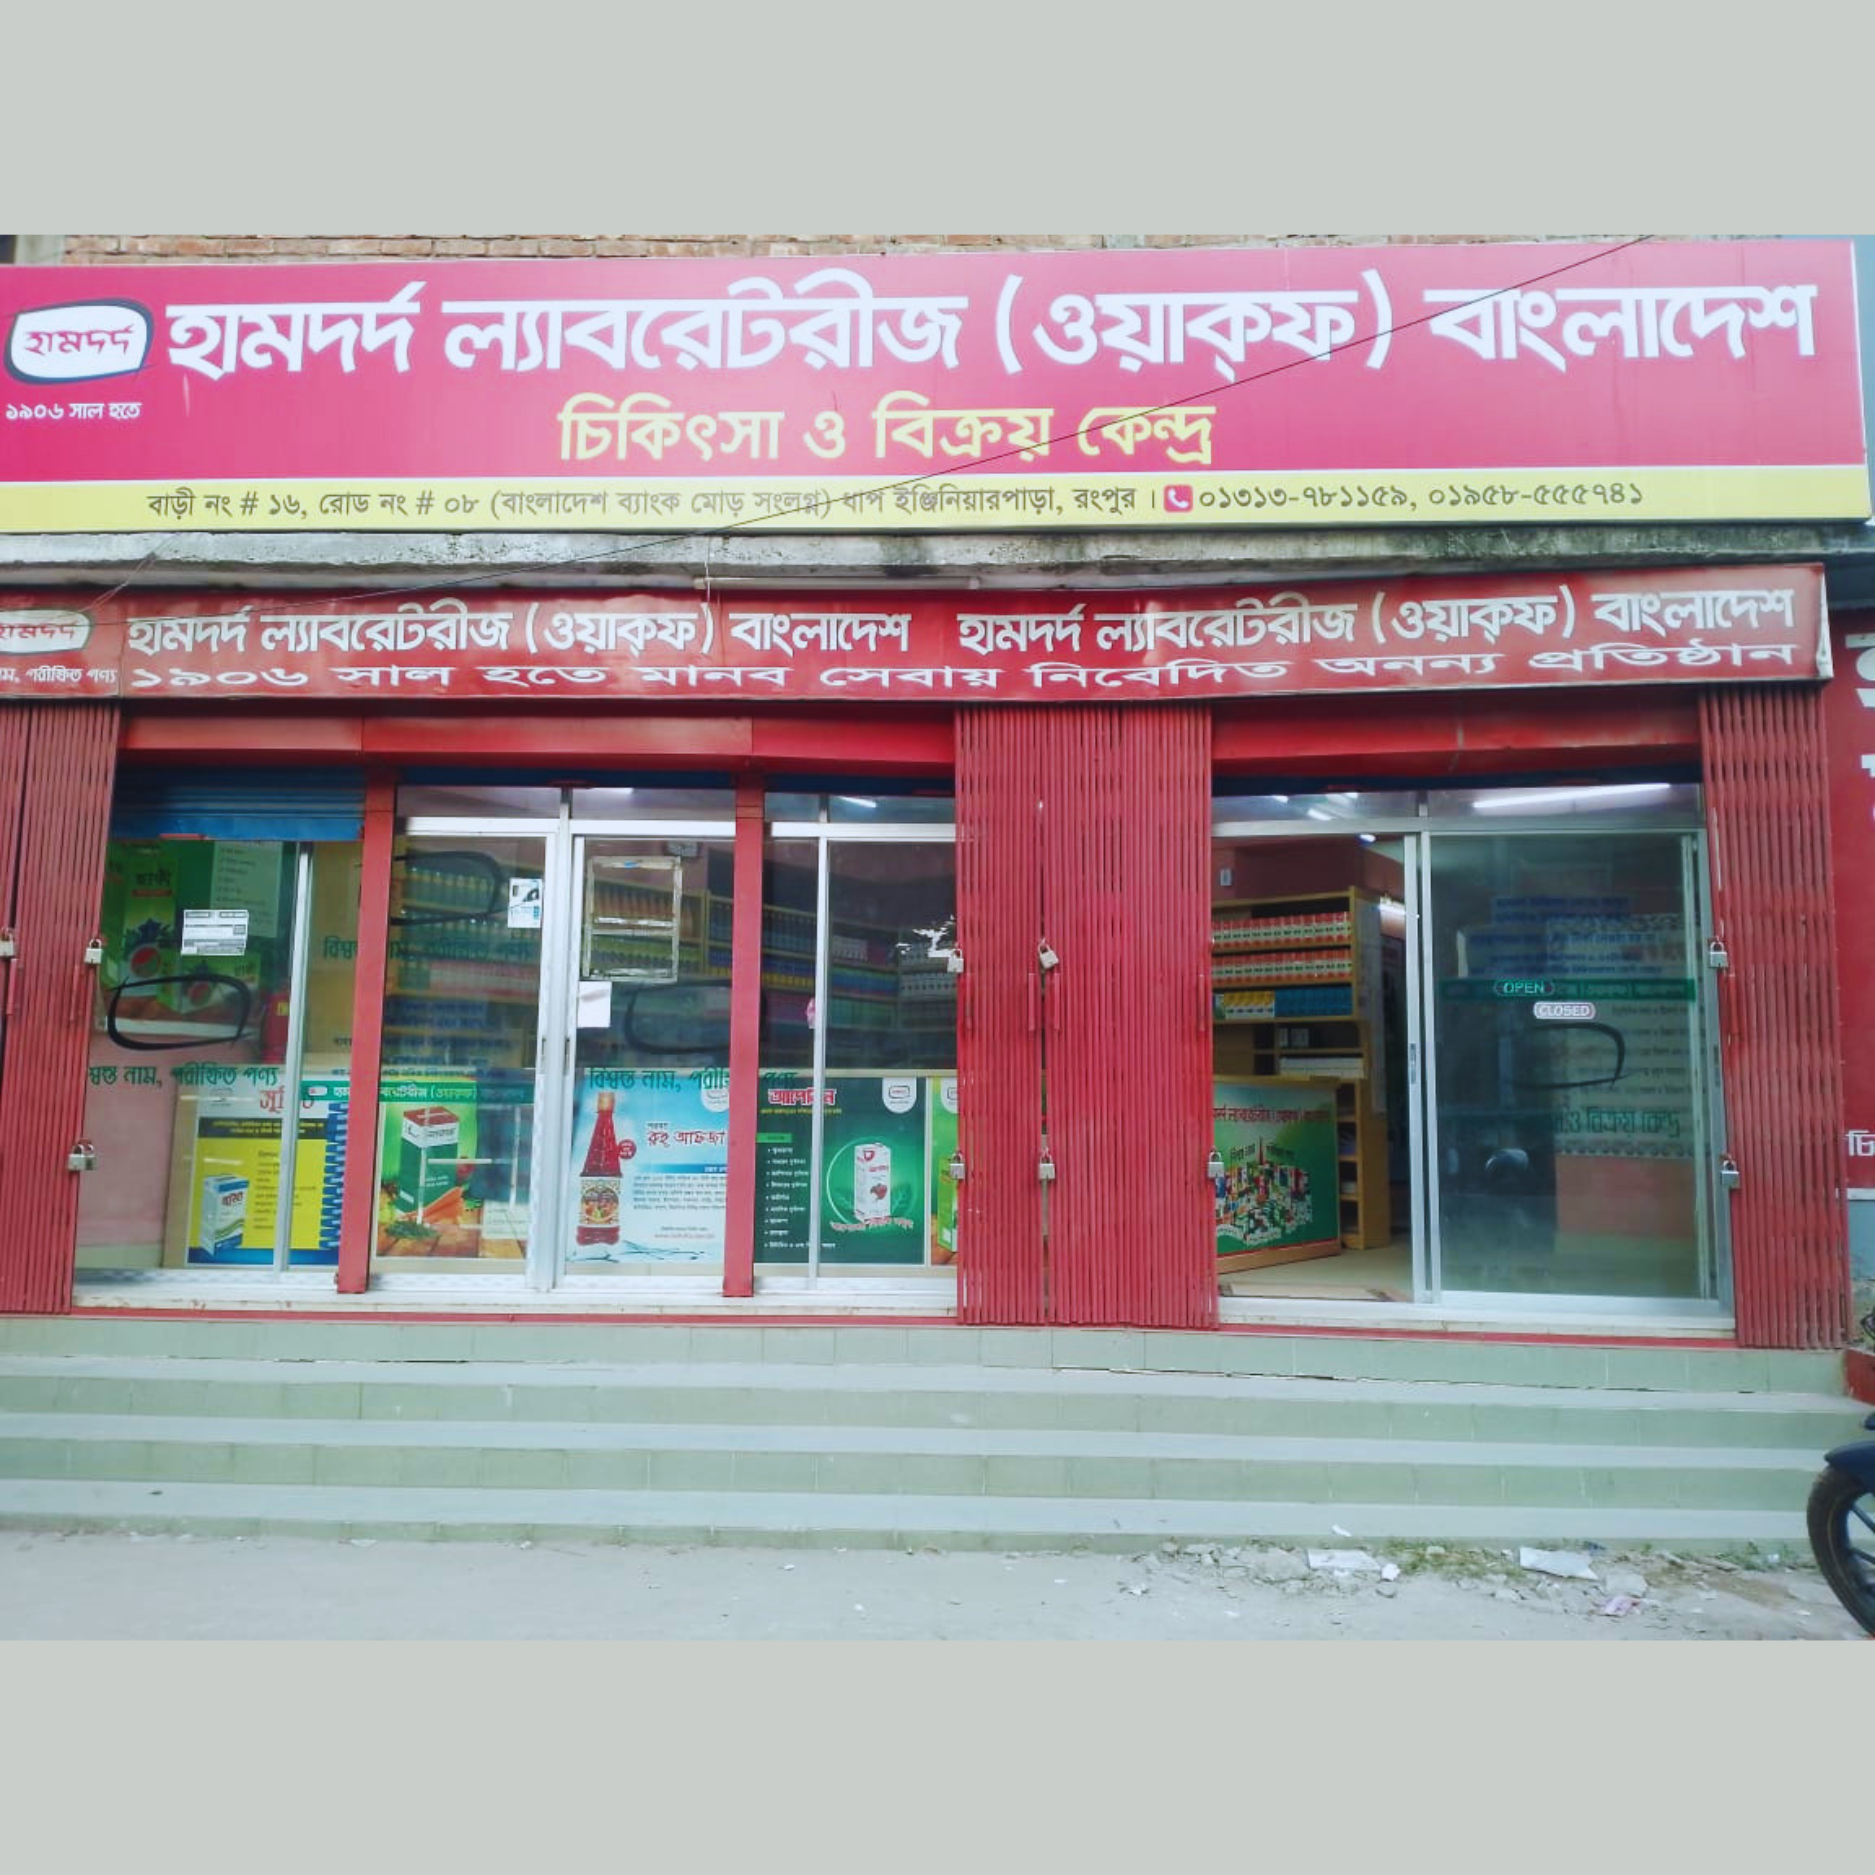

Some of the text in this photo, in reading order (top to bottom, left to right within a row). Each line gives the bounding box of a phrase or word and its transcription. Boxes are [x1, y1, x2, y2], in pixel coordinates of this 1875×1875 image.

[24, 325, 135, 357] হামদর্দ
[166, 280, 428, 380] হামদর্দ
[441, 267, 968, 373] ল্যাবরেটরীজ
[1423, 285, 1818, 373] বাংলাদেশ
[5, 401, 143, 421] ১৯০৬ সাল হতে
[557, 390, 1217, 465] চিকিৎসা ও বিক্রয় কেন্দ্র
[146, 487, 195, 520] বাড়ী
[204, 493, 231, 518] নং
[240, 491, 259, 513] #
[269, 493, 308, 520] ১৬,
[319, 491, 371, 515] রোড
[379, 492, 407, 516] নং
[416, 490, 435, 512] #
[444, 497, 479, 515] ০৮
[491, 489, 608, 520] (বাংলাদেশ
[617, 490, 681, 516] ব্যাংক
[691, 489, 745, 519] মোড়
[842, 487, 884, 513] ধাপ
[1074, 487, 1136, 515] রংপুর
[1429, 482, 1643, 507] ০১৯৫৮-৫৫৫৭৪১
[126, 605, 253, 656] হামদর্দ
[260, 597, 514, 653] ল্যাবরেটরীজ
[729, 613, 911, 656] বাংলাদেশ
[957, 604, 1086, 656] হামদর্দ
[1094, 596, 1358, 653] ল্যাবরেটরীজ
[1591, 588, 1795, 638] বাংলাদেশ
[131, 637, 1800, 689] ১৯০৬ সাল হতে মানব সেবায় নিবেদিত অনন্য প্রতিষ্ঠান
[1503, 980, 1545, 994] OPEN
[1538, 1004, 1591, 1017] CLOSED
[242, 1066, 280, 1087] পণ্য
